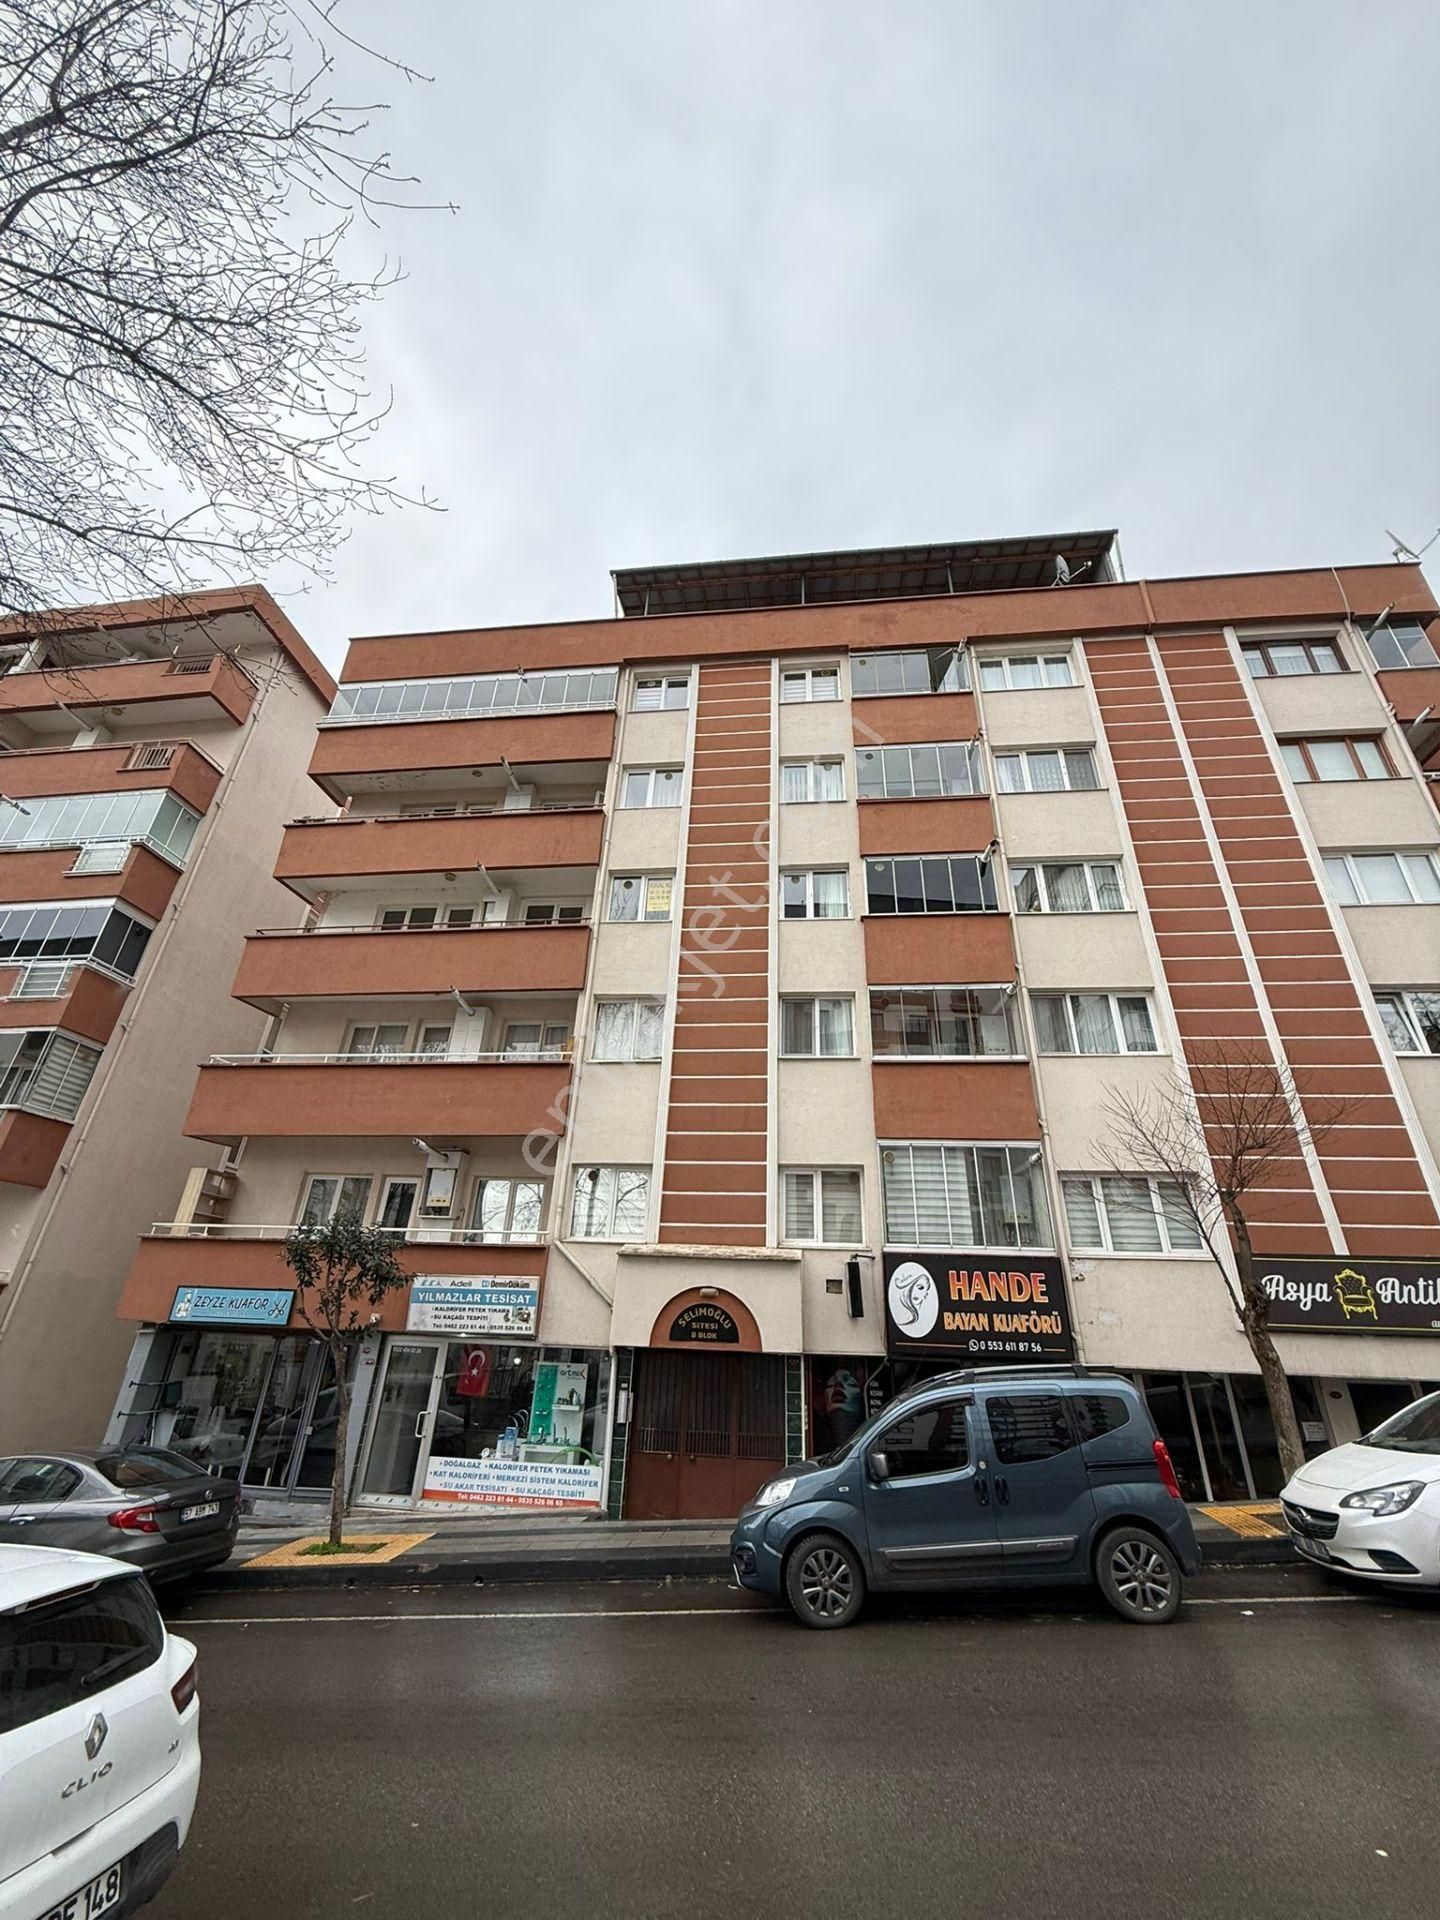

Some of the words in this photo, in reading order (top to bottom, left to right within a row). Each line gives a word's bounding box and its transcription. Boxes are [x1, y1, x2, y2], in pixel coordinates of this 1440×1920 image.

[949, 1270, 1049, 1303] HANDE
[1261, 1274, 1333, 1312] Asya
[194, 1296, 228, 1308] ZEYZE
[418, 1291, 481, 1303] YILMAZLAR
[485, 1291, 532, 1304] TESİSAT
[678, 1307, 732, 1329] SELİMOĞLU
[943, 1311, 989, 1332] BAYAN
[993, 1310, 1062, 1334] KUAFÖRÜ
[980, 1341, 986, 1350] 0
[987, 1341, 1003, 1351] 553
[1005, 1342, 1017, 1351] 611
[1019, 1342, 1029, 1352] 87
[1031, 1343, 1042, 1353] 56
[443, 1460, 481, 1469] DOĞALGAZ
[489, 1463, 528, 1472] KALORİFER
[529, 1465, 553, 1473] PETEK
[555, 1466, 591, 1476] YIKAMASI
[433, 1470, 447, 1478] KAT
[496, 1474, 528, 1483] MERKEZİ
[529, 1475, 556, 1485] SİSTEM
[557, 1478, 598, 1488] KALORİFER
[454, 1482, 475, 1490] AKAR
[61, 1762, 113, 1799] CLIO
[84, 1868, 119, 1920] 148
